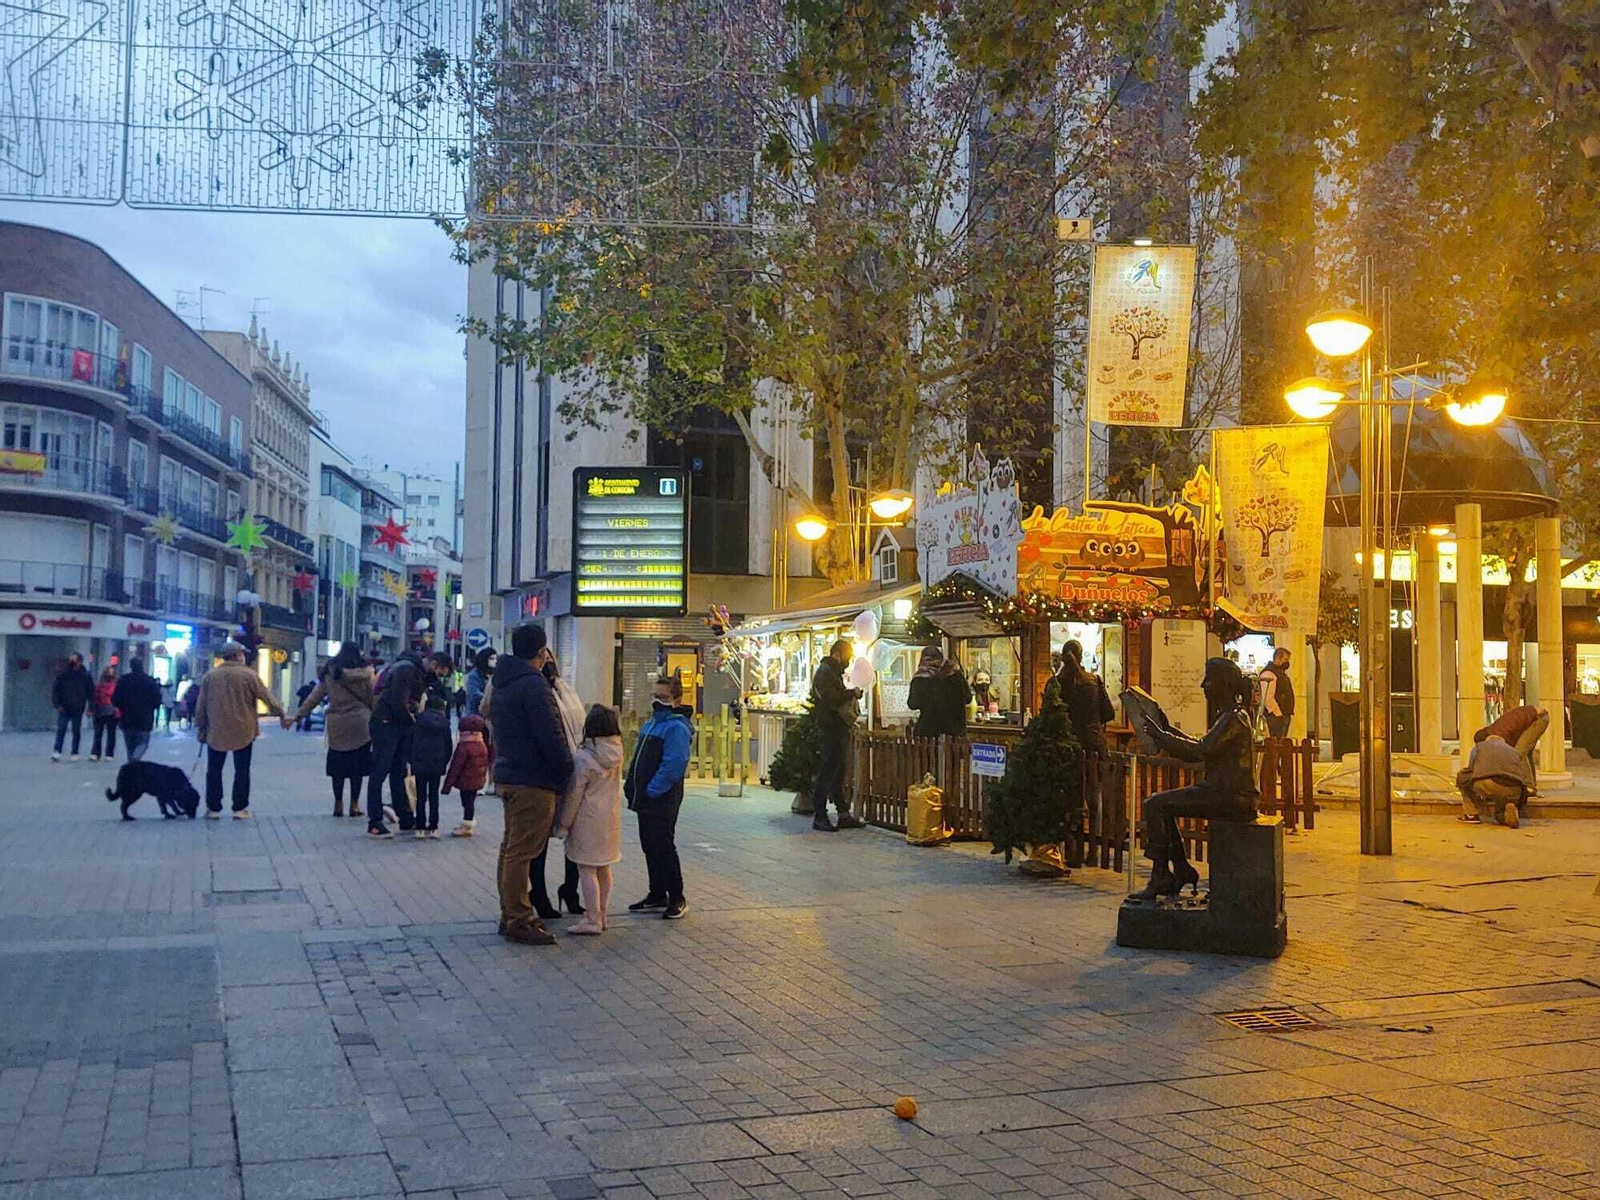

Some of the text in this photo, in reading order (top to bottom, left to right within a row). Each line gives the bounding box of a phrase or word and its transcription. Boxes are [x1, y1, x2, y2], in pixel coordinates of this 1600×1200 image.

[607, 519, 649, 527] VIERNES
[1027, 506, 1158, 536] La Casita de Leticia
[614, 550, 626, 558] DE
[630, 550, 660, 558] ENERO
[1060, 582, 1149, 602] Buñuelos
[973, 748, 996, 758] ENTRADA
